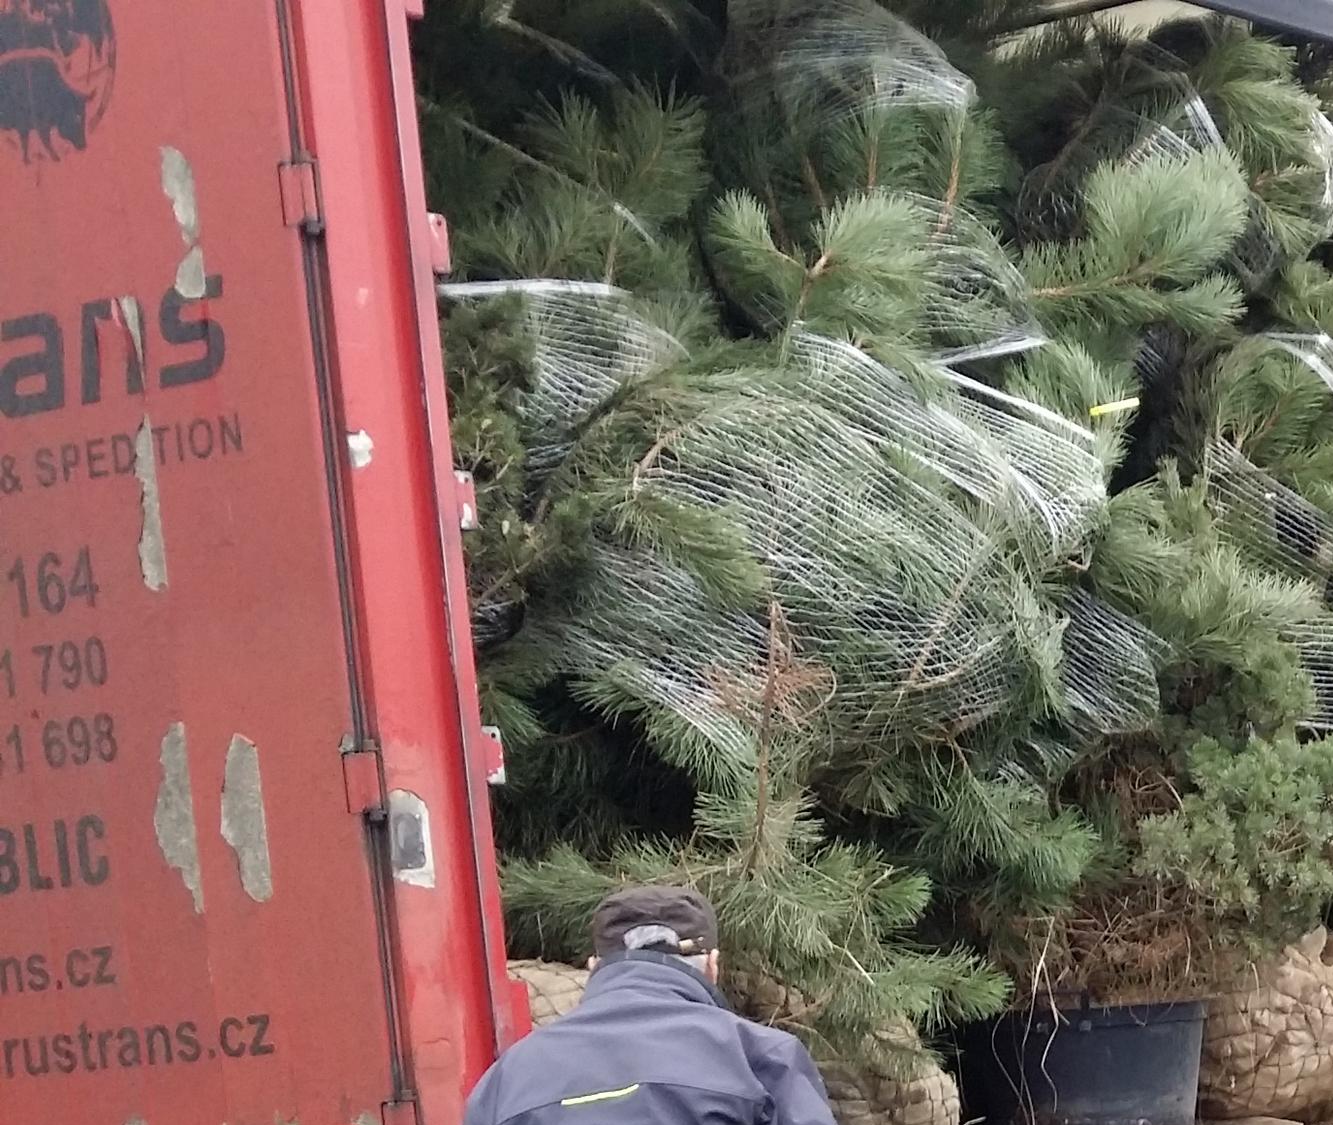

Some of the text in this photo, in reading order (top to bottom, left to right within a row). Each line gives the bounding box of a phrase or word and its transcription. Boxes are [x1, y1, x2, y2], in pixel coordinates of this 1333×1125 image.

[0, 412, 243, 494] & SPEDTION
[8, 545, 101, 619] 164
[32, 636, 108, 694] 790
[0, 712, 118, 774] 1 698
[0, 946, 117, 995] ns.cz
[3, 1014, 275, 1079] rustrans.cz
